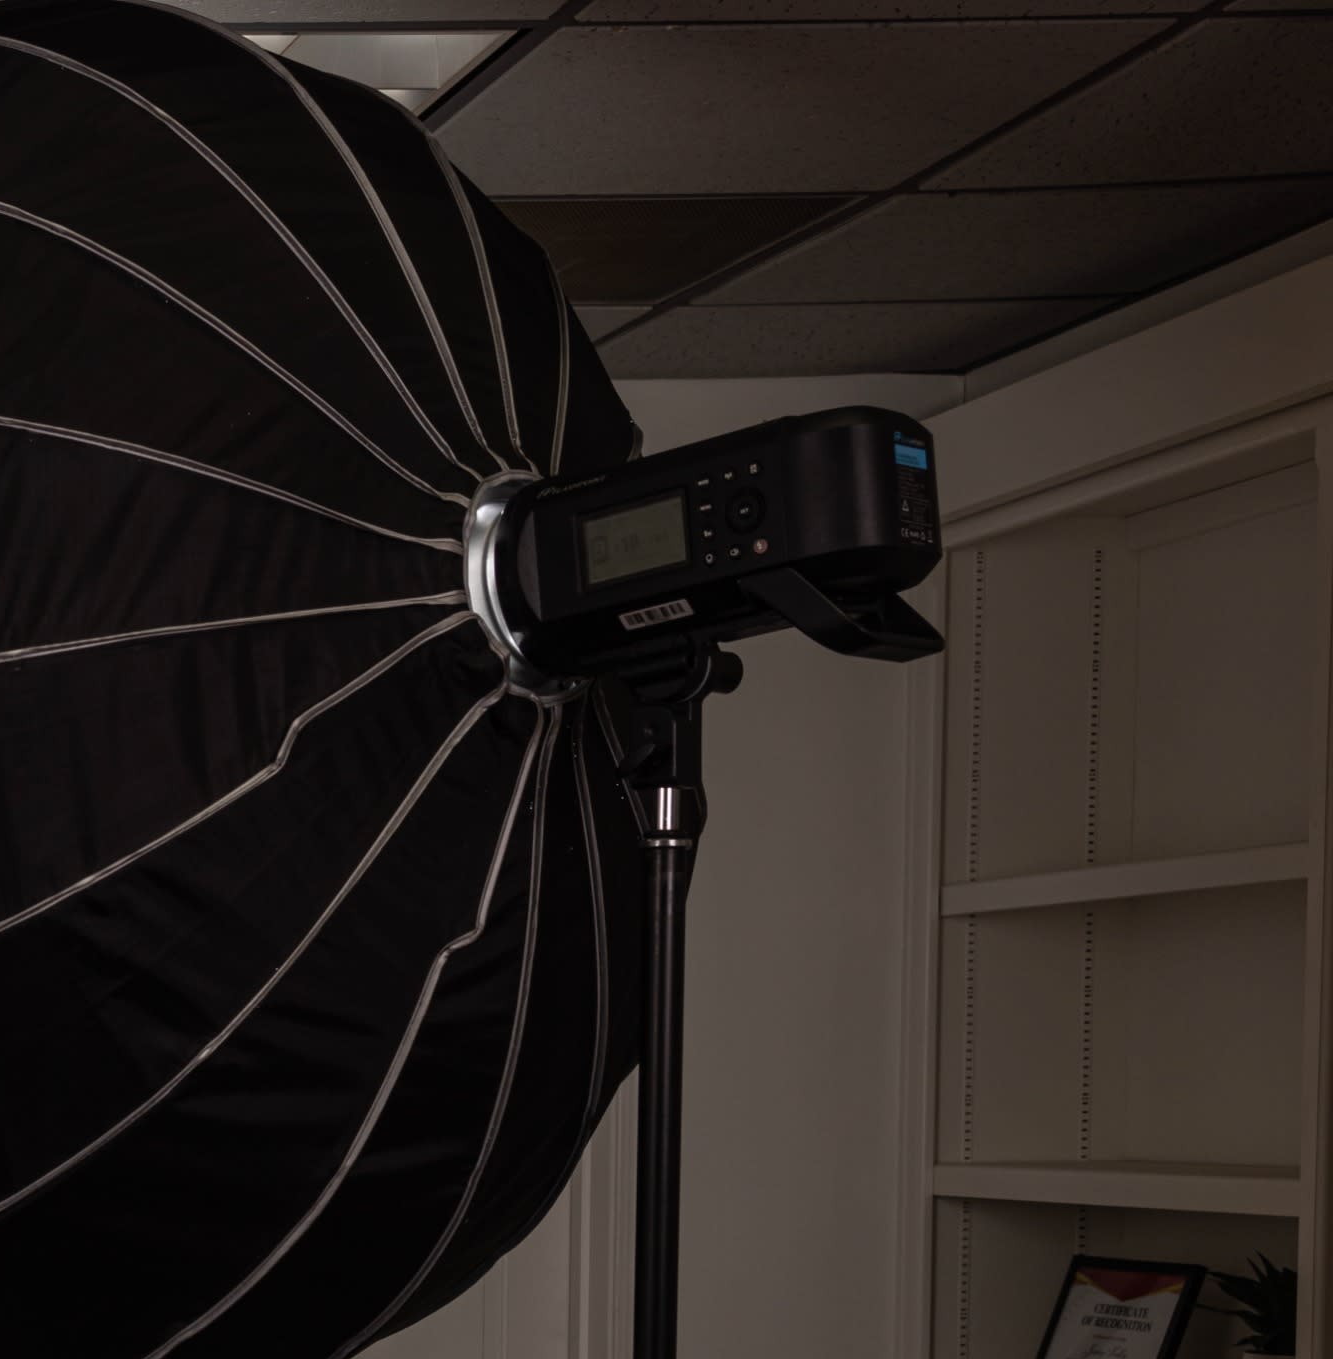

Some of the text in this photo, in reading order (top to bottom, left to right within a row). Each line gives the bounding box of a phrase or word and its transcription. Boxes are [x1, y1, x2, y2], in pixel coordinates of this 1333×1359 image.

[1094, 1303, 1149, 1319] CERTIFICATE
[1081, 1315, 1152, 1333] OF RECOGNITION
